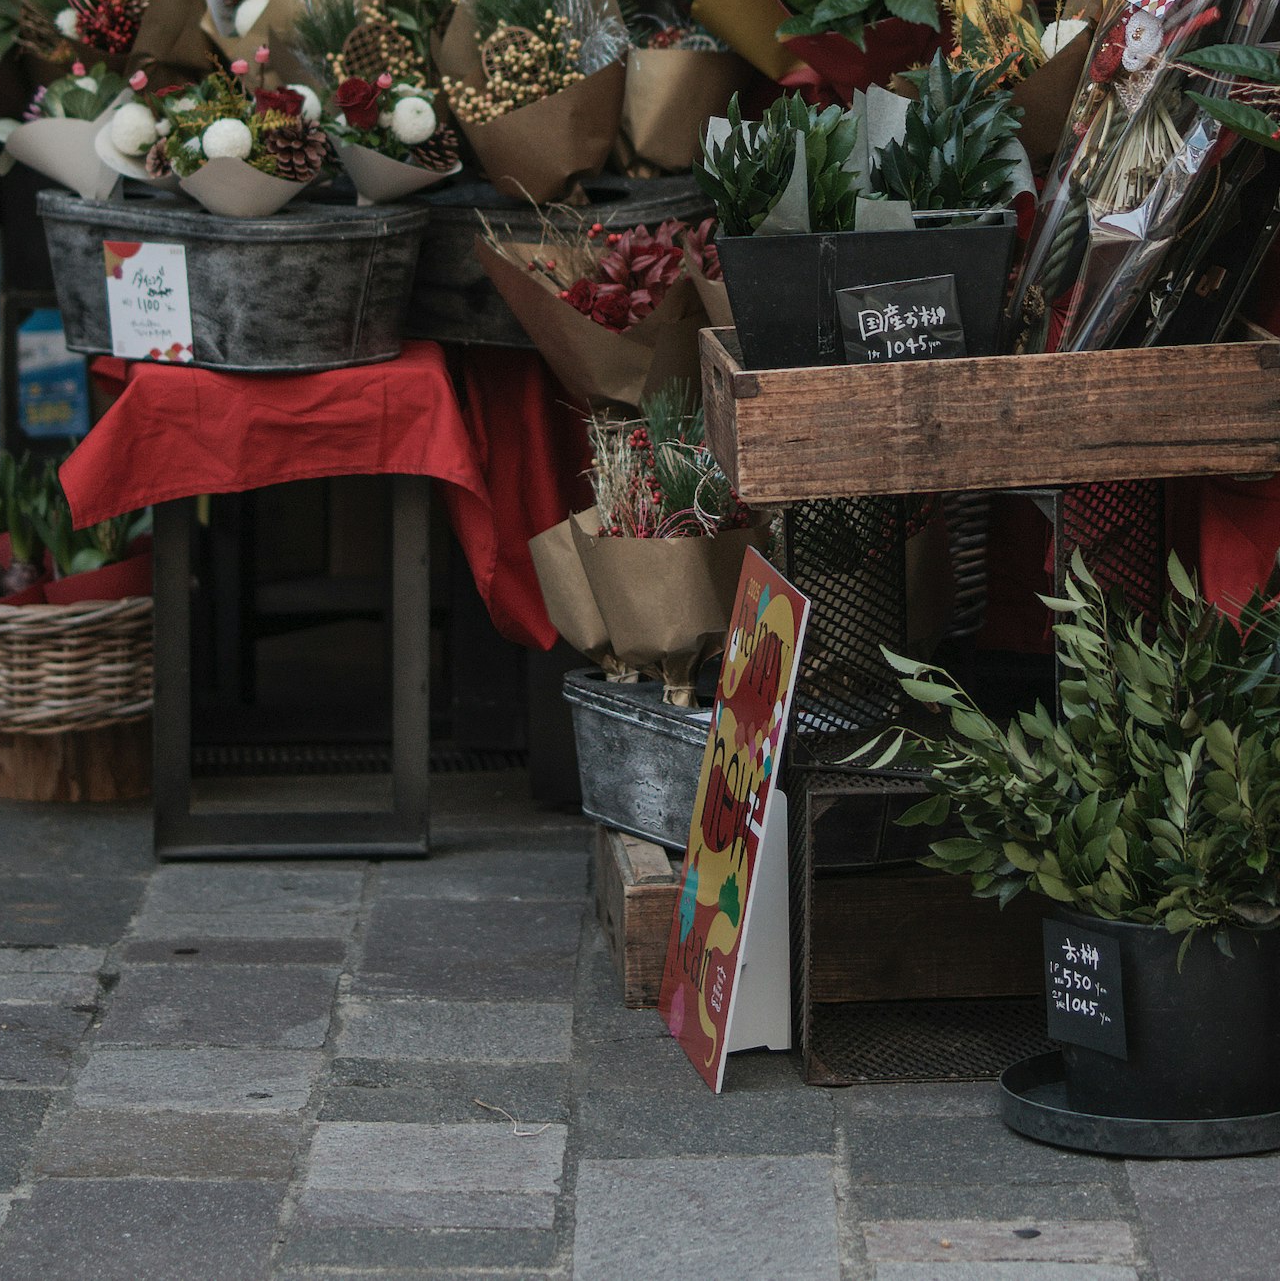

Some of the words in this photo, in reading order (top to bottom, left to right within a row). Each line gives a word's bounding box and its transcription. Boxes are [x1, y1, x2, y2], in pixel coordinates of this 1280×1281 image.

[858, 303, 946, 341] 国産お榊
[886, 334, 928, 359] 1045
[928, 341, 942, 354] yen
[747, 576, 761, 603] 2025
[701, 726, 763, 873] new
[1050, 960, 1060, 973] 1P
[1061, 937, 1099, 971] お榊
[1063, 967, 1092, 991] 550
[1065, 992, 1099, 1016] 1045
